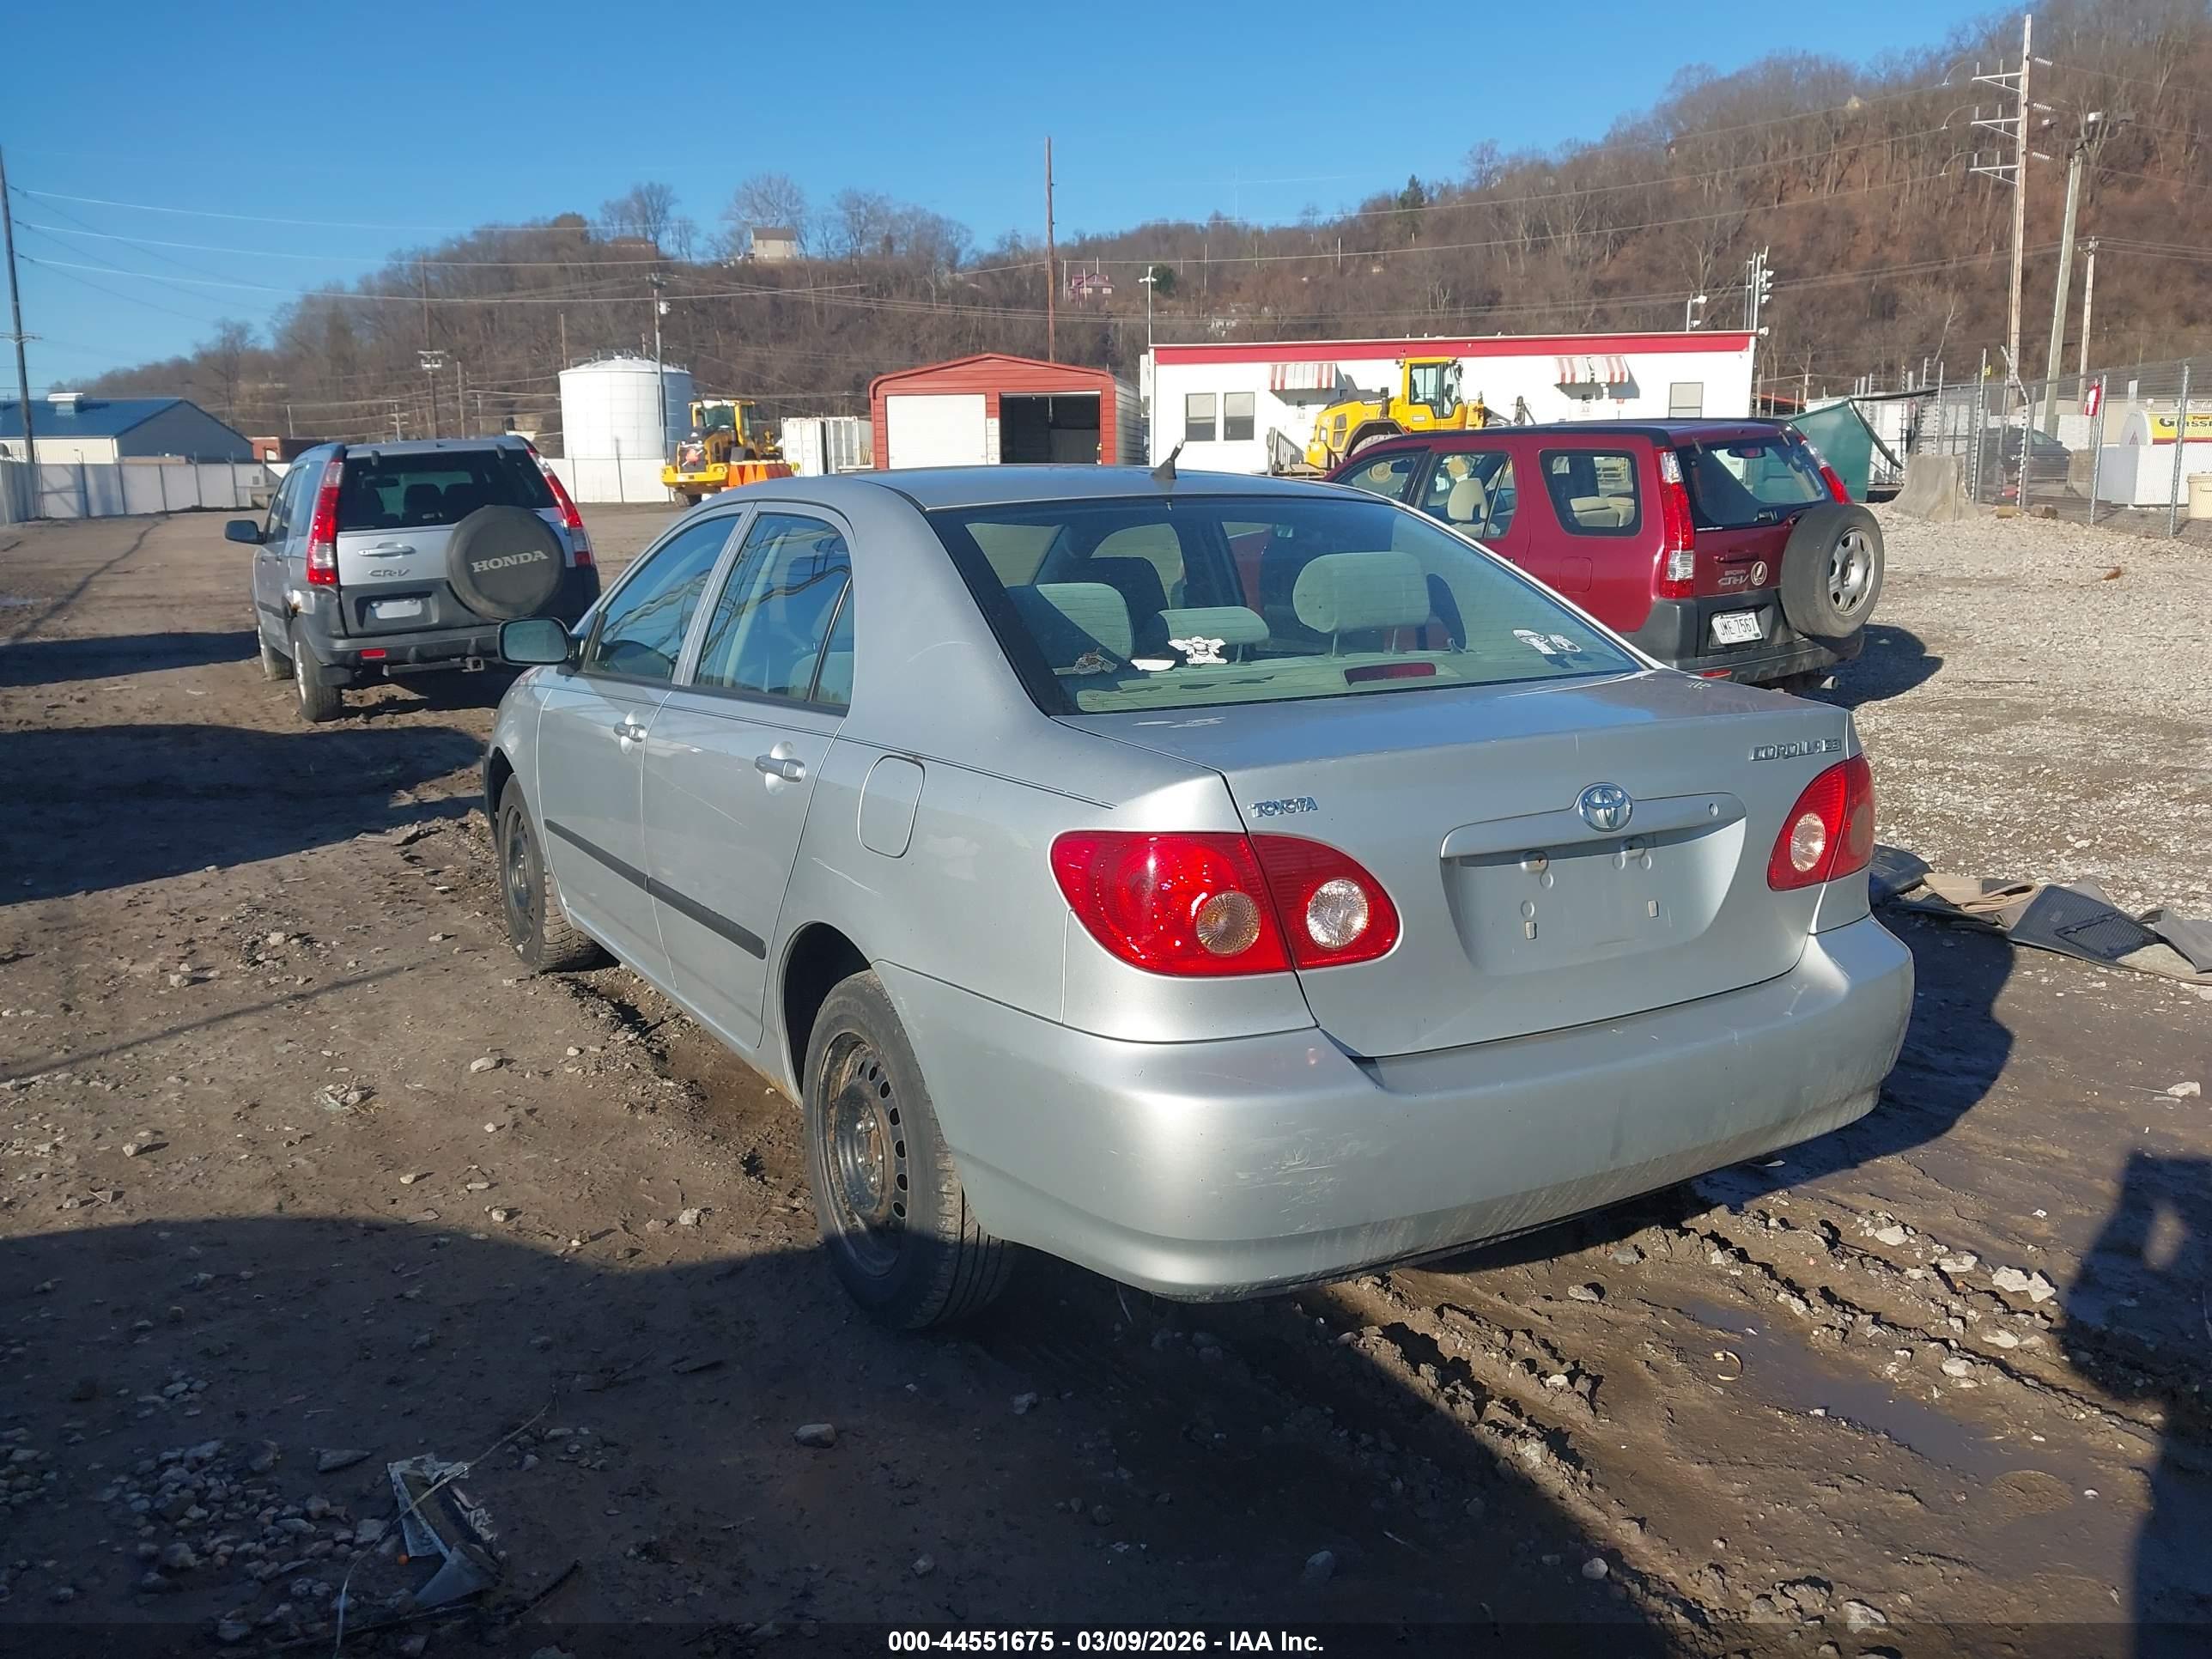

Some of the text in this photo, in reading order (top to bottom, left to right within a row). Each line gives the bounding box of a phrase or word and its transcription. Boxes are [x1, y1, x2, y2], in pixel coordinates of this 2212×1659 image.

[471, 550, 549, 574] HONDA
[368, 568, 411, 578] CR-V
[1734, 617, 1756, 633] 7567
[1250, 796, 1319, 818] TOYOTA
